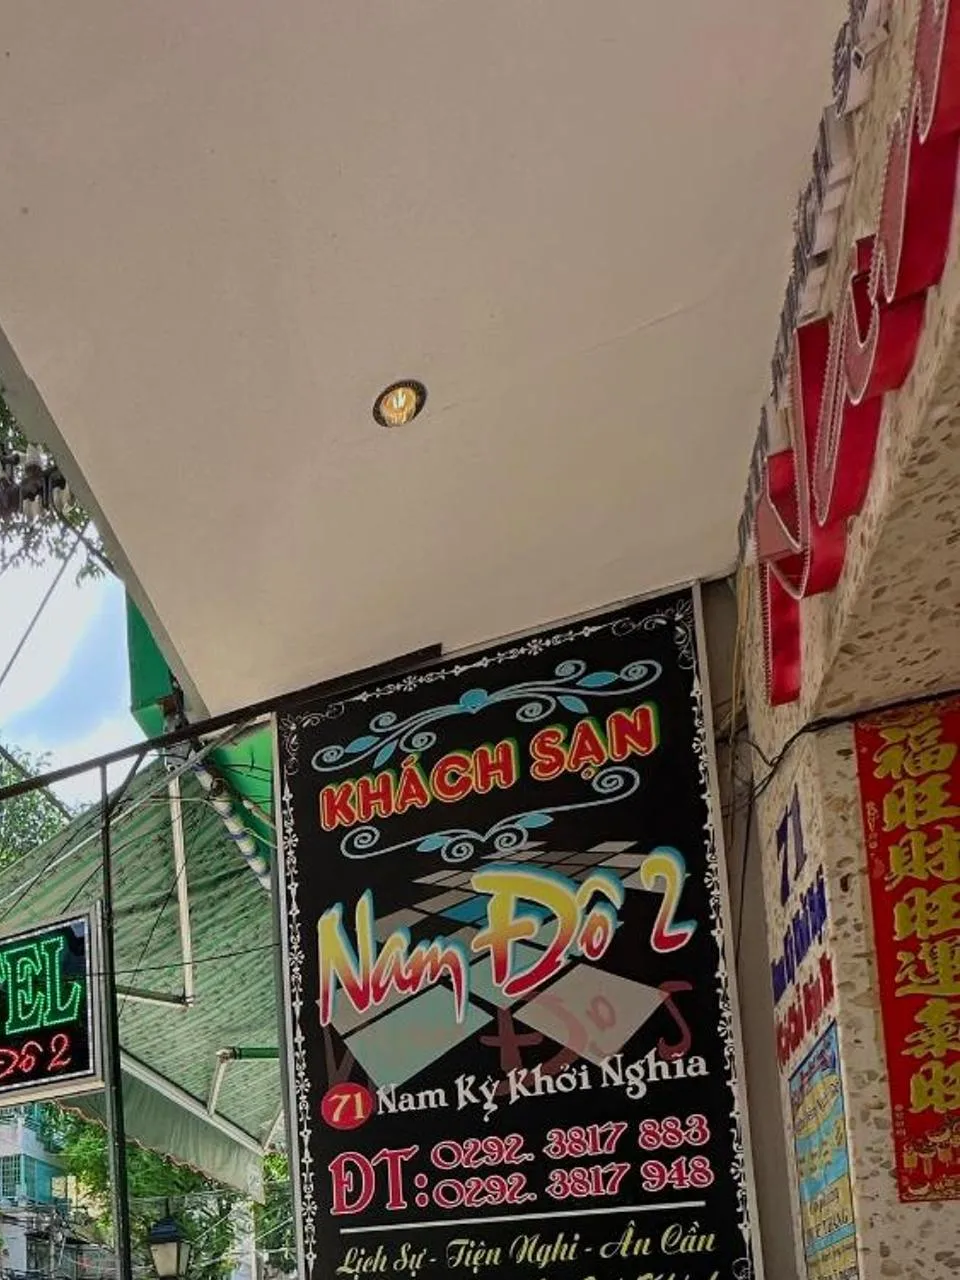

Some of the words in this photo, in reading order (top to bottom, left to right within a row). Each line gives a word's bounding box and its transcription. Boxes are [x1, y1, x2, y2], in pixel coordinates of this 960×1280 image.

[320, 736, 519, 832] KHÁCH
[528, 702, 661, 783] SẠN
[316, 888, 471, 1026] Nam
[470, 864, 626, 998] Đô
[640, 845, 698, 953] 2
[47, 1033, 72, 1071] 2
[329, 1091, 366, 1123] 71
[376, 1086, 447, 1116] Nam
[454, 1073, 500, 1122] Kỳ
[508, 1062, 590, 1104] Khởi
[600, 1050, 709, 1100] Nghĩa
[329, 1144, 428, 1216] ĐT:
[430, 1133, 534, 1169] 0292.
[543, 1122, 628, 1159] 3817
[638, 1114, 711, 1149] 883
[432, 1173, 537, 1209] 0292.
[544, 1162, 630, 1199] 3817
[641, 1156, 715, 1191] 948
[336, 1245, 387, 1280] Lịch
[393, 1243, 427, 1277] Sự
[446, 1236, 501, 1273] Tiện
[509, 1232, 577, 1270] Nghi
[600, 1219, 651, 1258] Ân
[660, 1221, 715, 1254] Cần
